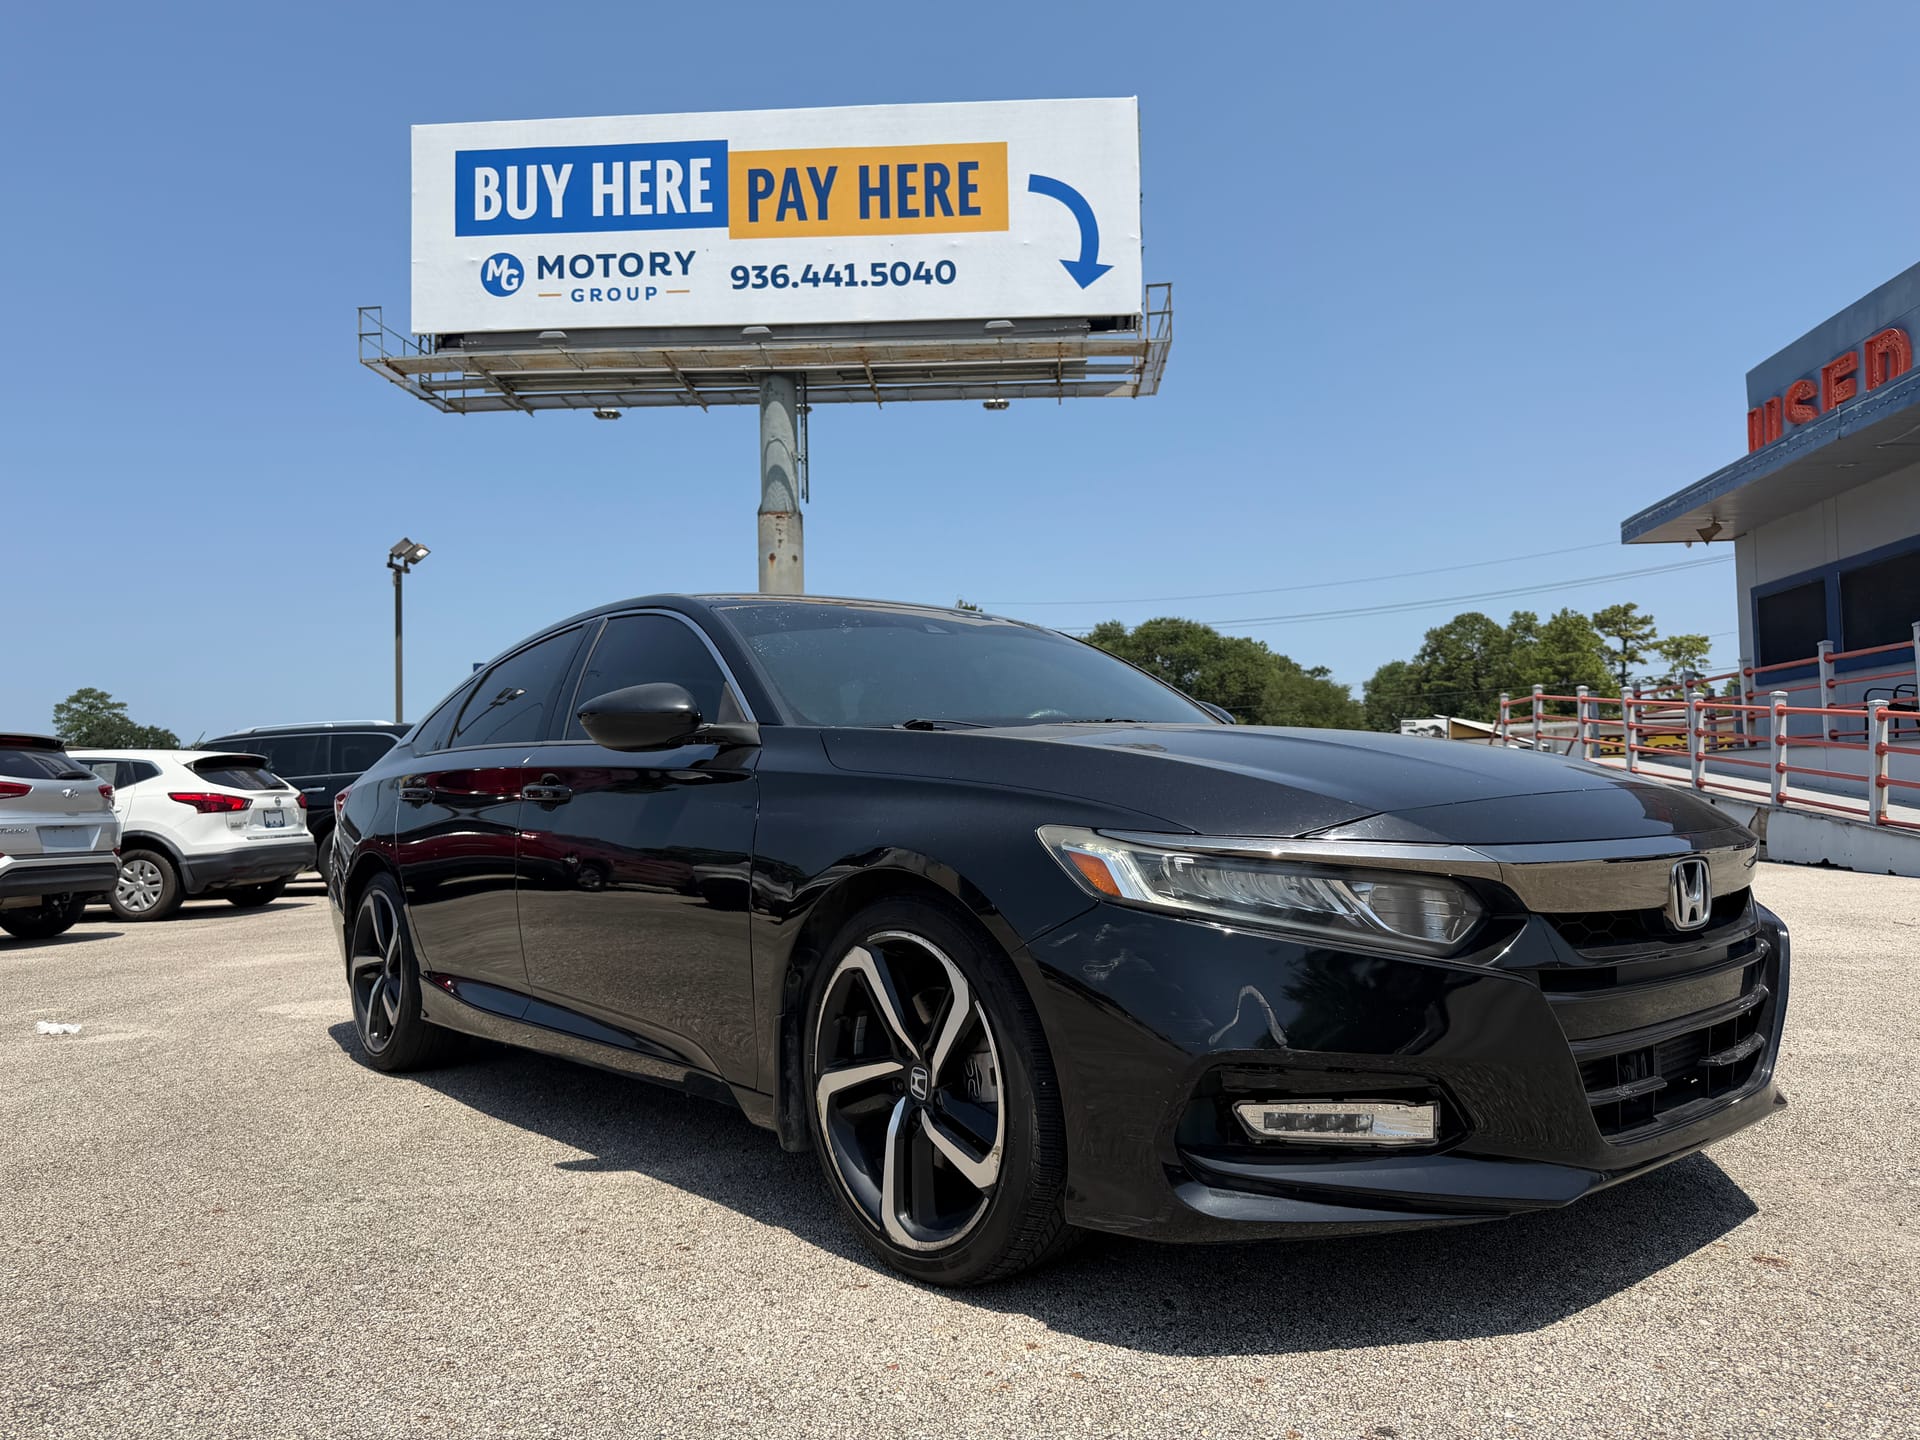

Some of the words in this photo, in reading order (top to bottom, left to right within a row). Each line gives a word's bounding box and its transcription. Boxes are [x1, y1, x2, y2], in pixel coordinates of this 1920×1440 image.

[474, 163, 574, 221] BUY
[592, 158, 713, 217] HERE
[747, 166, 838, 222] PAY
[858, 161, 981, 220] HERE
[485, 257, 522, 292] MG
[537, 250, 696, 280] MOTORY
[730, 260, 957, 290] 936.441.5040
[571, 286, 658, 303] GROUP
